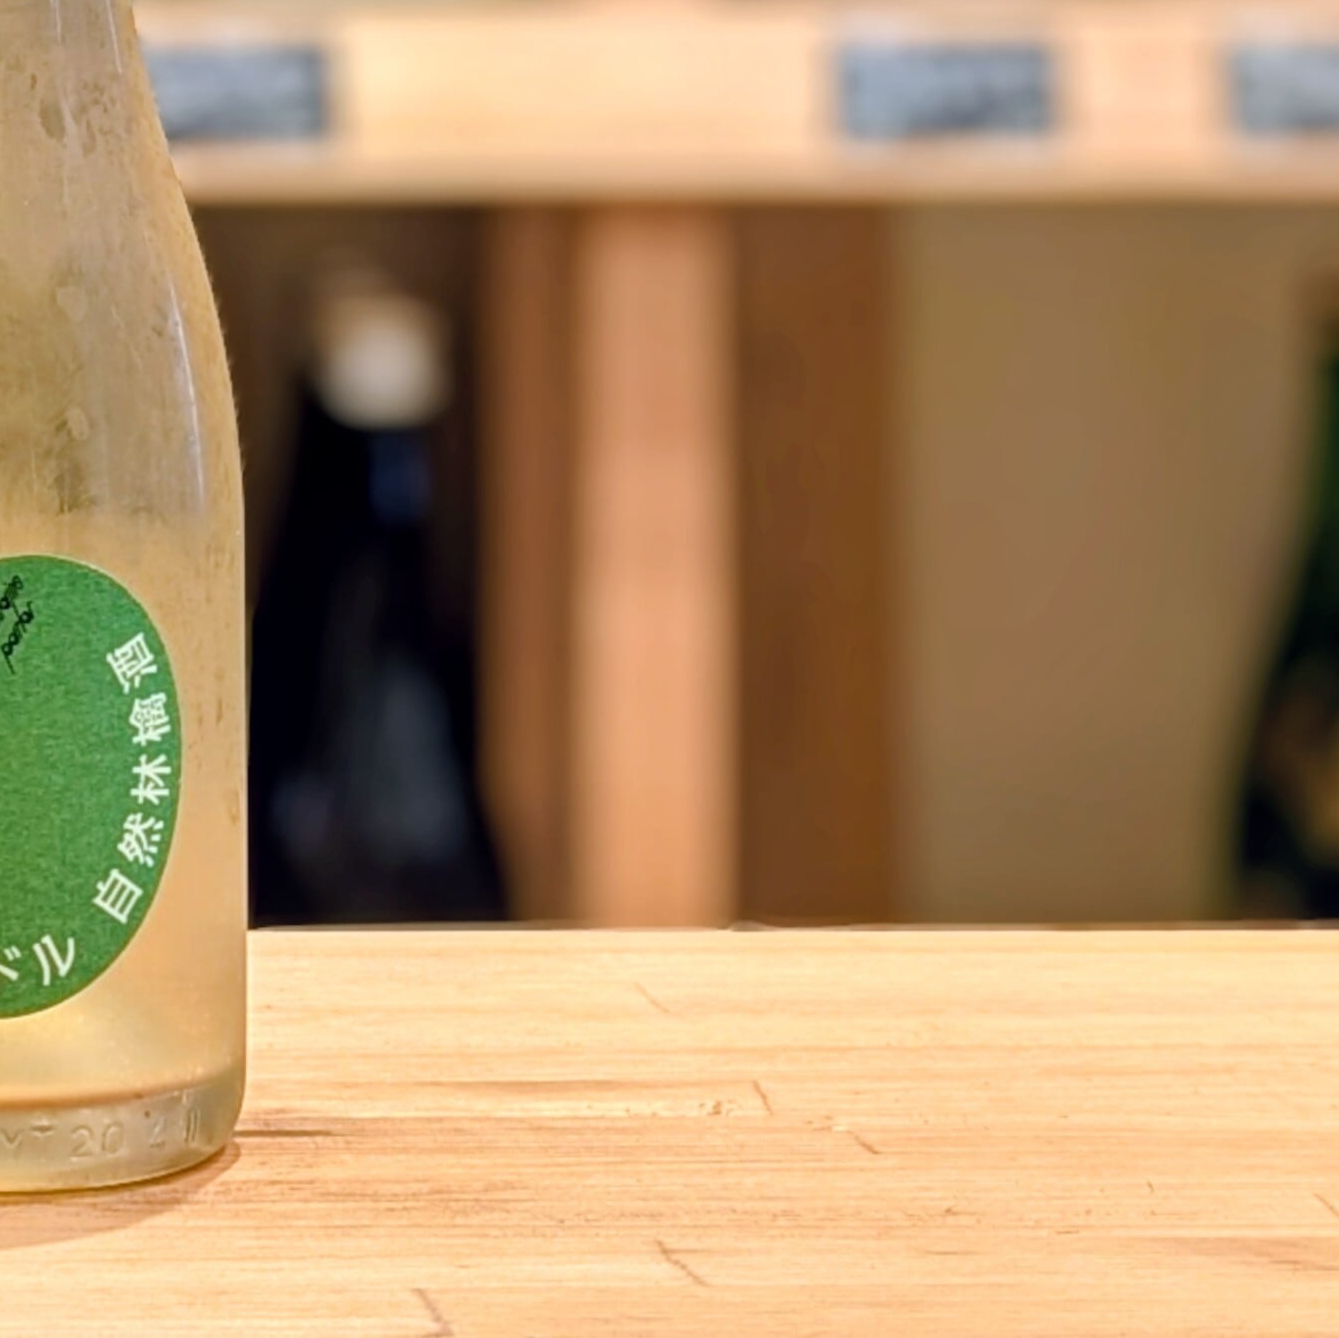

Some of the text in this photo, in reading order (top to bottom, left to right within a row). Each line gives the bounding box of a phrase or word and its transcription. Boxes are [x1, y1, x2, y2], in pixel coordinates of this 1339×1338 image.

[92, 631, 172, 924] 自然林檎酒
